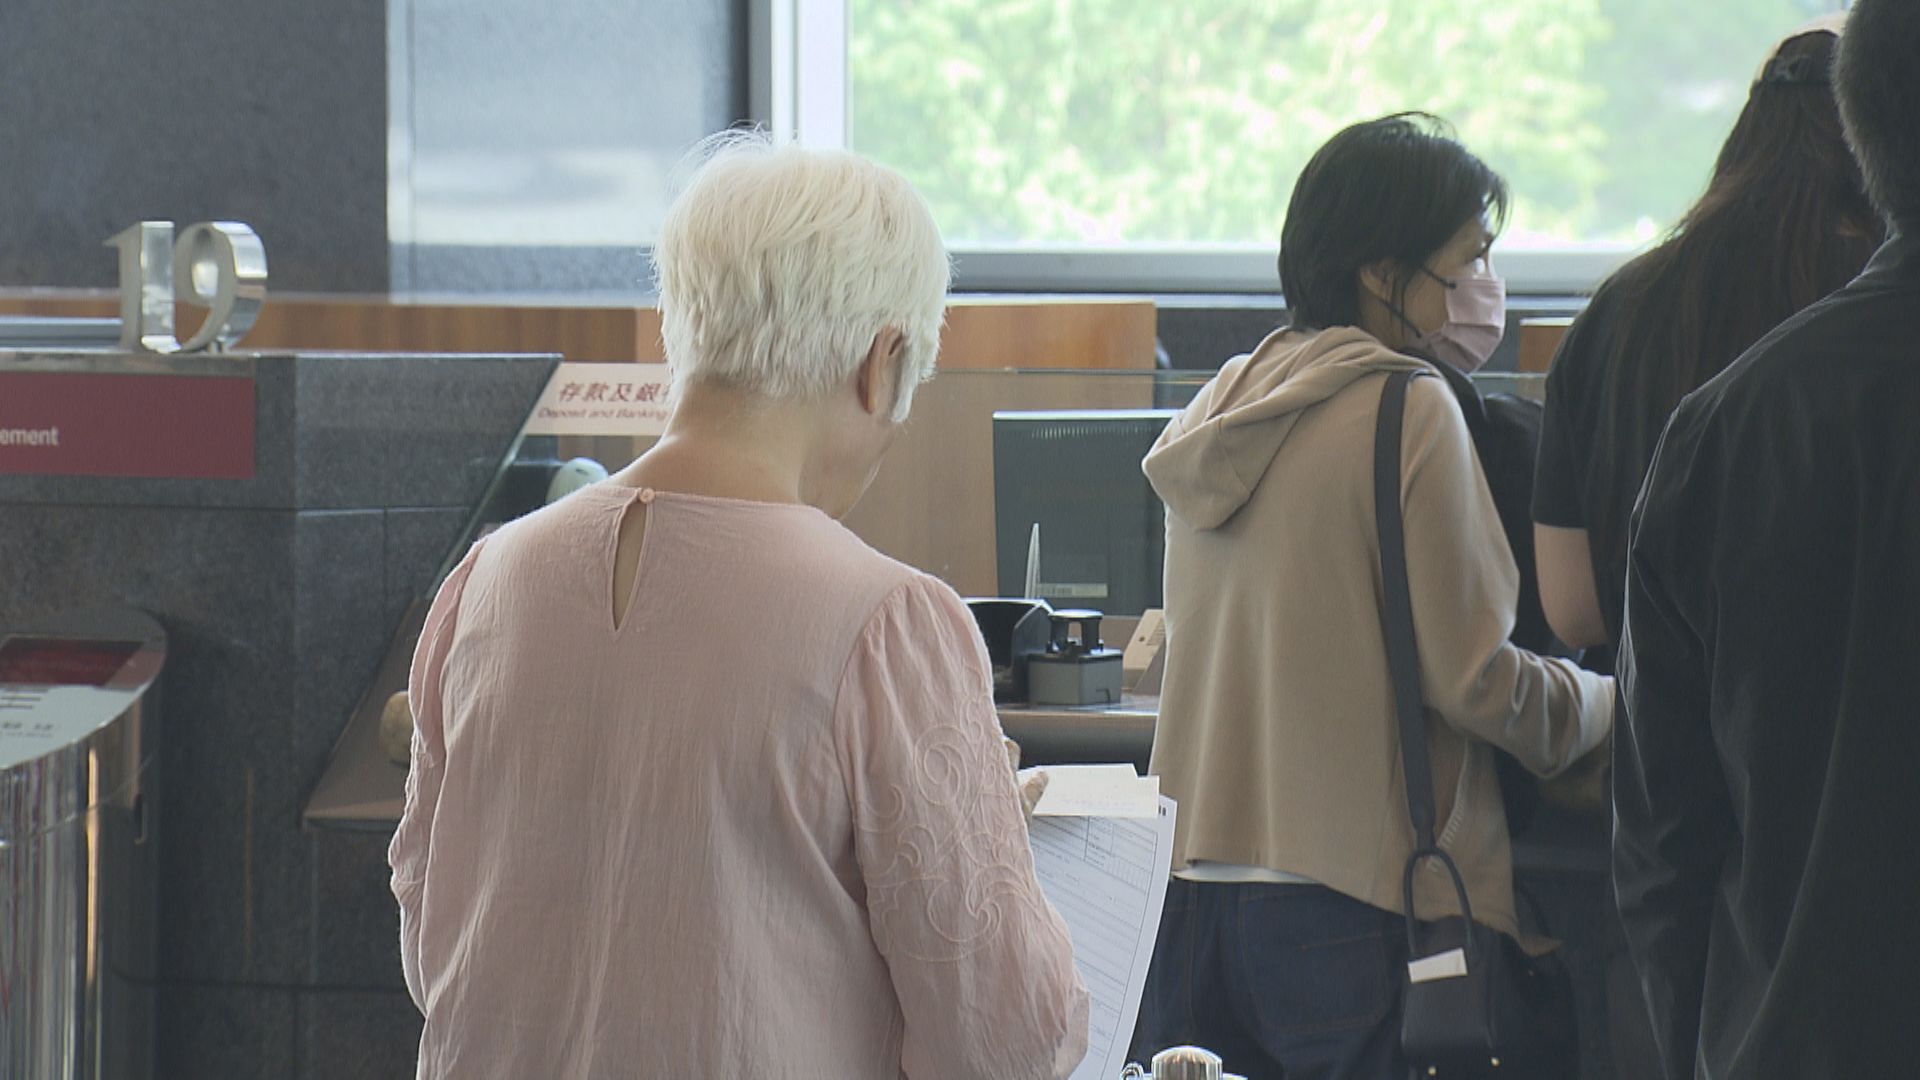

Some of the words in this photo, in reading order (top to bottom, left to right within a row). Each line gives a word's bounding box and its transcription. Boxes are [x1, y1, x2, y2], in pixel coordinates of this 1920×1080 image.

[102, 220, 268, 354] 19
[537, 407, 587, 419] Deposit
[588, 407, 615, 418] and
[616, 407, 668, 422] Banking
